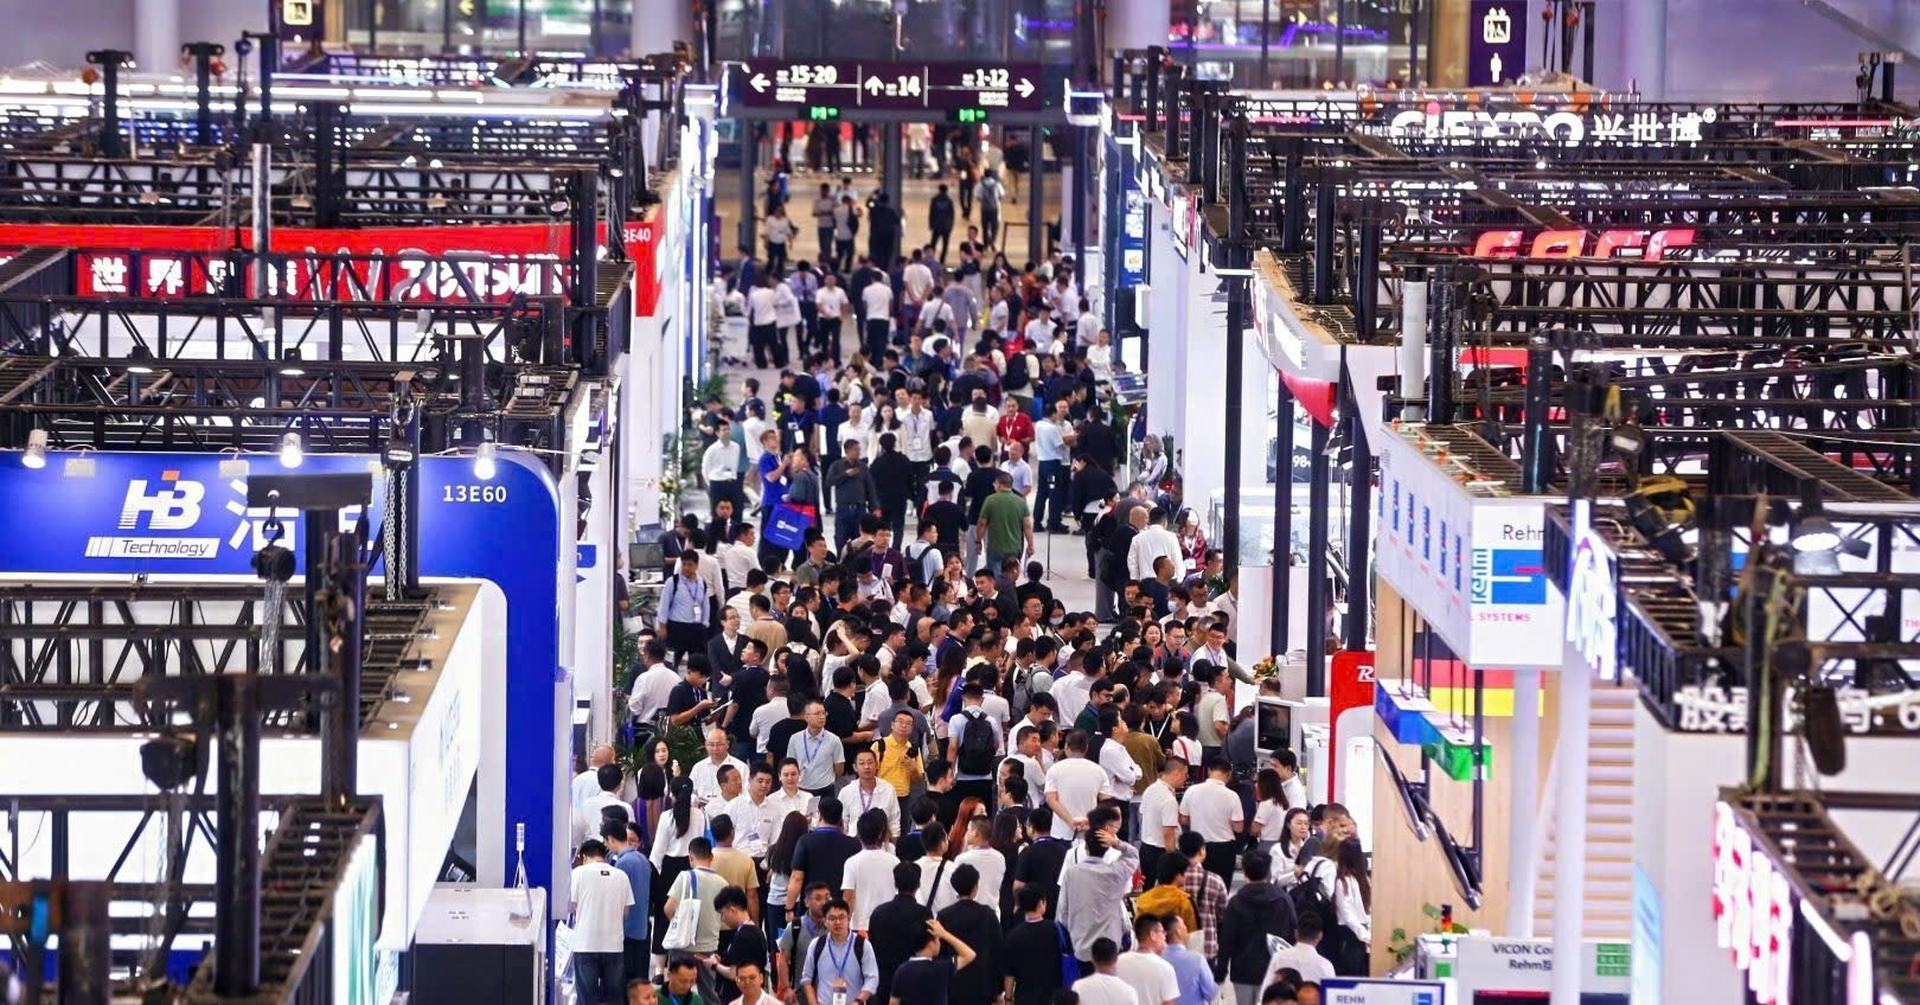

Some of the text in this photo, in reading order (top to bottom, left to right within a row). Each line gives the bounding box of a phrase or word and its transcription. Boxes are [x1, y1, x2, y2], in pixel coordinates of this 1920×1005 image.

[790, 65, 838, 84] 15-20
[976, 68, 1009, 88] 1-12
[898, 75, 921, 97] 14
[443, 485, 507, 503] 13E60
[121, 539, 210, 557] Technology
[1479, 612, 1532, 622] SYSTEMS
[1336, 994, 1366, 1005] REHM
